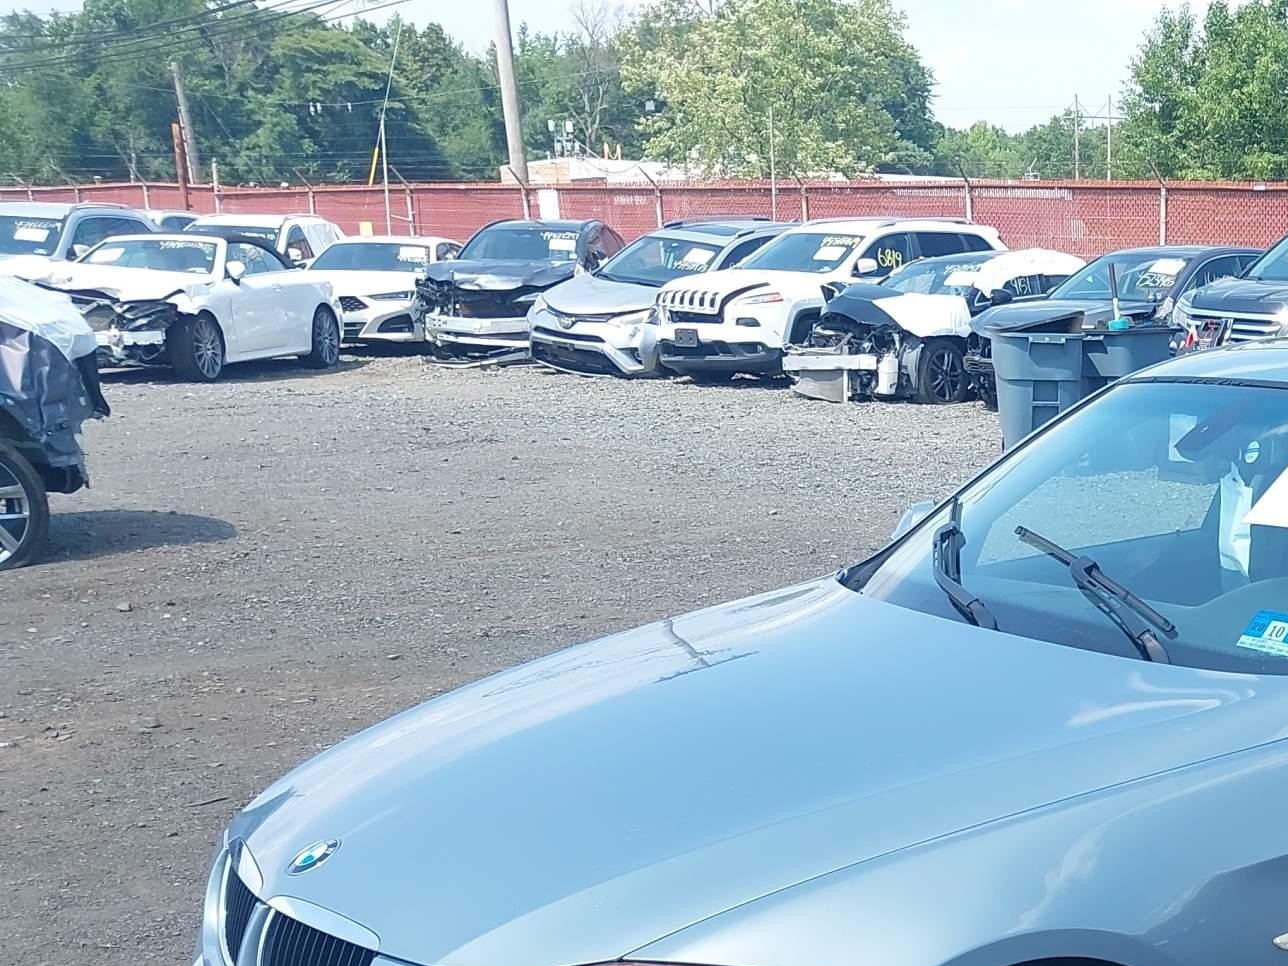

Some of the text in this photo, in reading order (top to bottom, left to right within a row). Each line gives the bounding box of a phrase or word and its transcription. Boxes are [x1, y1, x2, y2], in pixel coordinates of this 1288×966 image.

[877, 248, 903, 268] 6819
[1251, 622, 1266, 632] 20
[1267, 624, 1286, 639] 10
